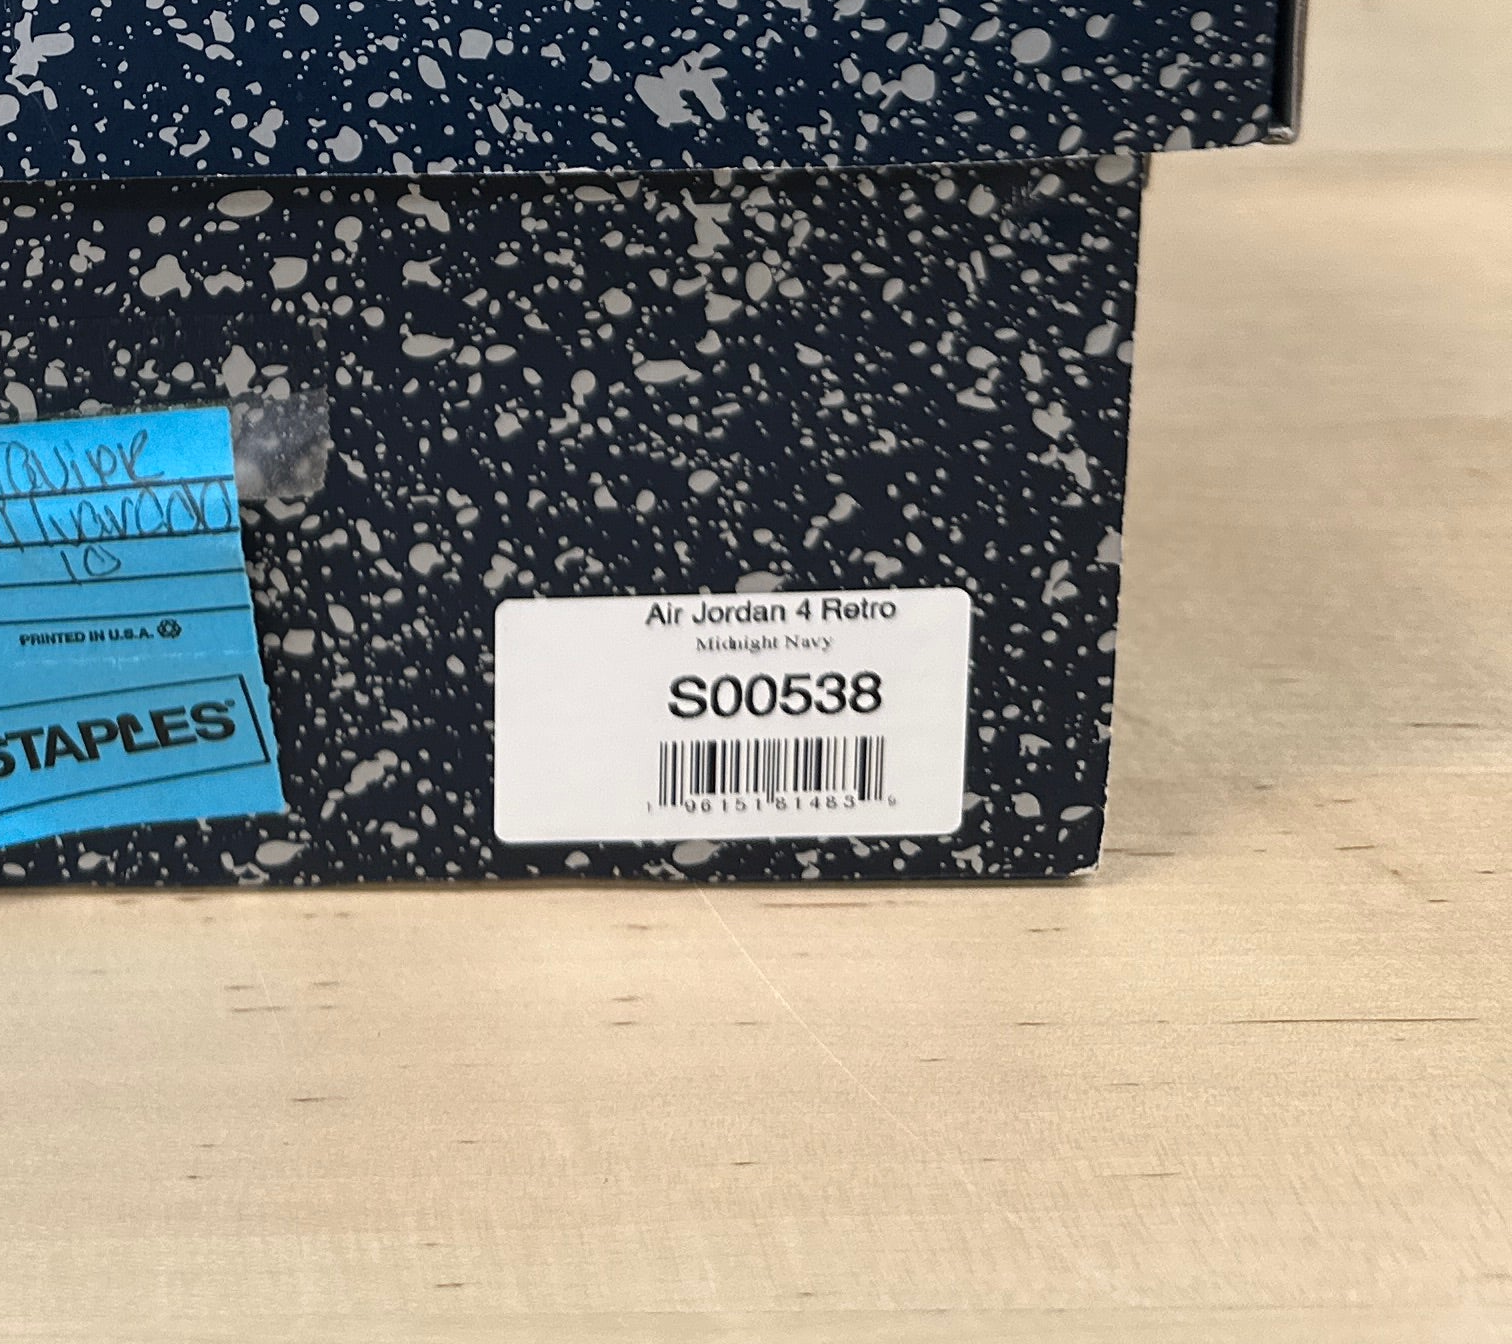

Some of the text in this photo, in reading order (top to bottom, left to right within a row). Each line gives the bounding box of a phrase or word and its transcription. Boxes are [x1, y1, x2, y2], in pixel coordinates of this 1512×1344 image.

[60, 544, 122, 585] 10
[645, 597, 897, 625] Air Jordan 4 Retro
[19, 626, 155, 646] PRINTED IN U.S.A.
[696, 634, 833, 653] Midnight Navy
[667, 669, 882, 718] S00538
